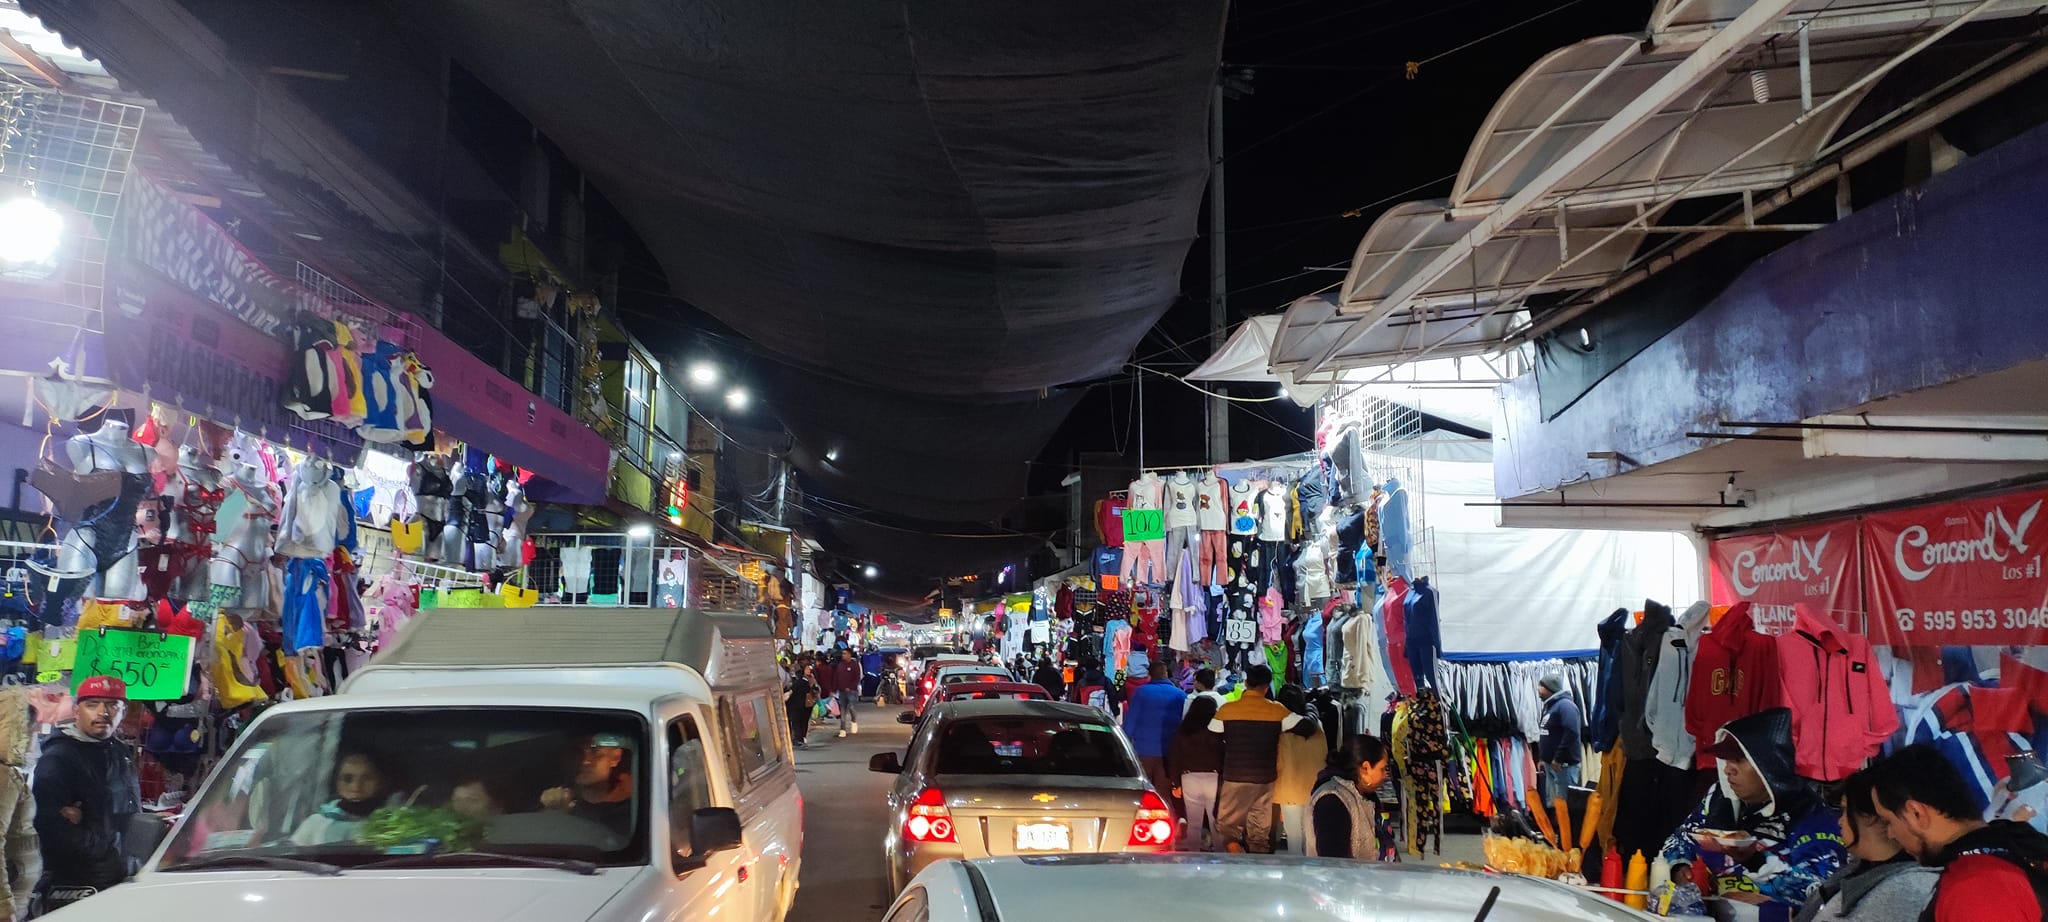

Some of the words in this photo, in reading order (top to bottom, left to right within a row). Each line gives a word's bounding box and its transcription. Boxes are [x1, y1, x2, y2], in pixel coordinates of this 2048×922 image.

[1126, 511, 1161, 536] 100
[1894, 511, 2009, 582] Concord
[1732, 539, 1809, 597] Concord
[2026, 555, 2041, 578] #1
[939, 617, 955, 628] WC
[1230, 621, 1252, 640] 85
[1923, 611, 1956, 631] 595
[1961, 609, 1997, 630] 953
[2003, 607, 2048, 629] 3046
[49, 888, 94, 900] NIKE
